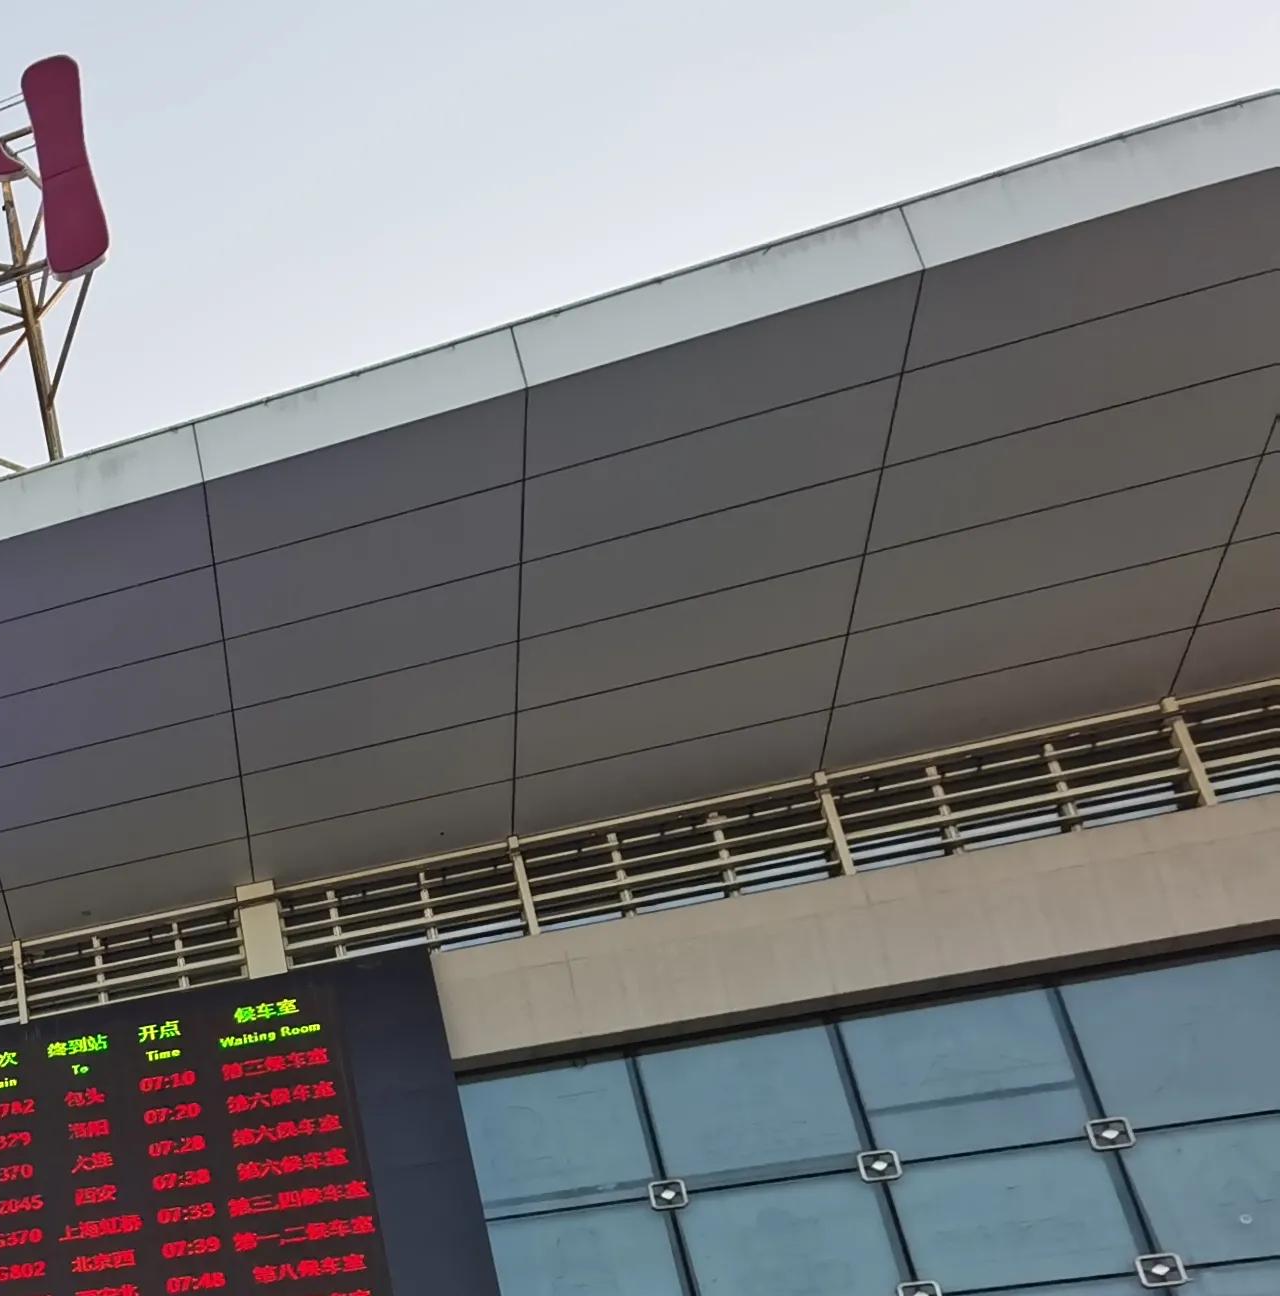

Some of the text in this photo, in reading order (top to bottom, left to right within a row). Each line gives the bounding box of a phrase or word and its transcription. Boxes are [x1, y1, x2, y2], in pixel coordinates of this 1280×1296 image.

[46, 1033, 108, 1058] 终到站
[138, 1020, 181, 1043] 开点
[233, 998, 300, 1023] 候车室
[71, 1063, 90, 1076] To
[145, 1049, 181, 1062] Time
[219, 1031, 277, 1048] Waiting
[280, 1023, 321, 1038] Room
[65, 1087, 105, 1107] 包头
[139, 1070, 197, 1092] 07:10
[221, 1047, 330, 1081] 第三候车室
[143, 1102, 202, 1125] 07:20
[160, 1236, 221, 1260] 07:39
